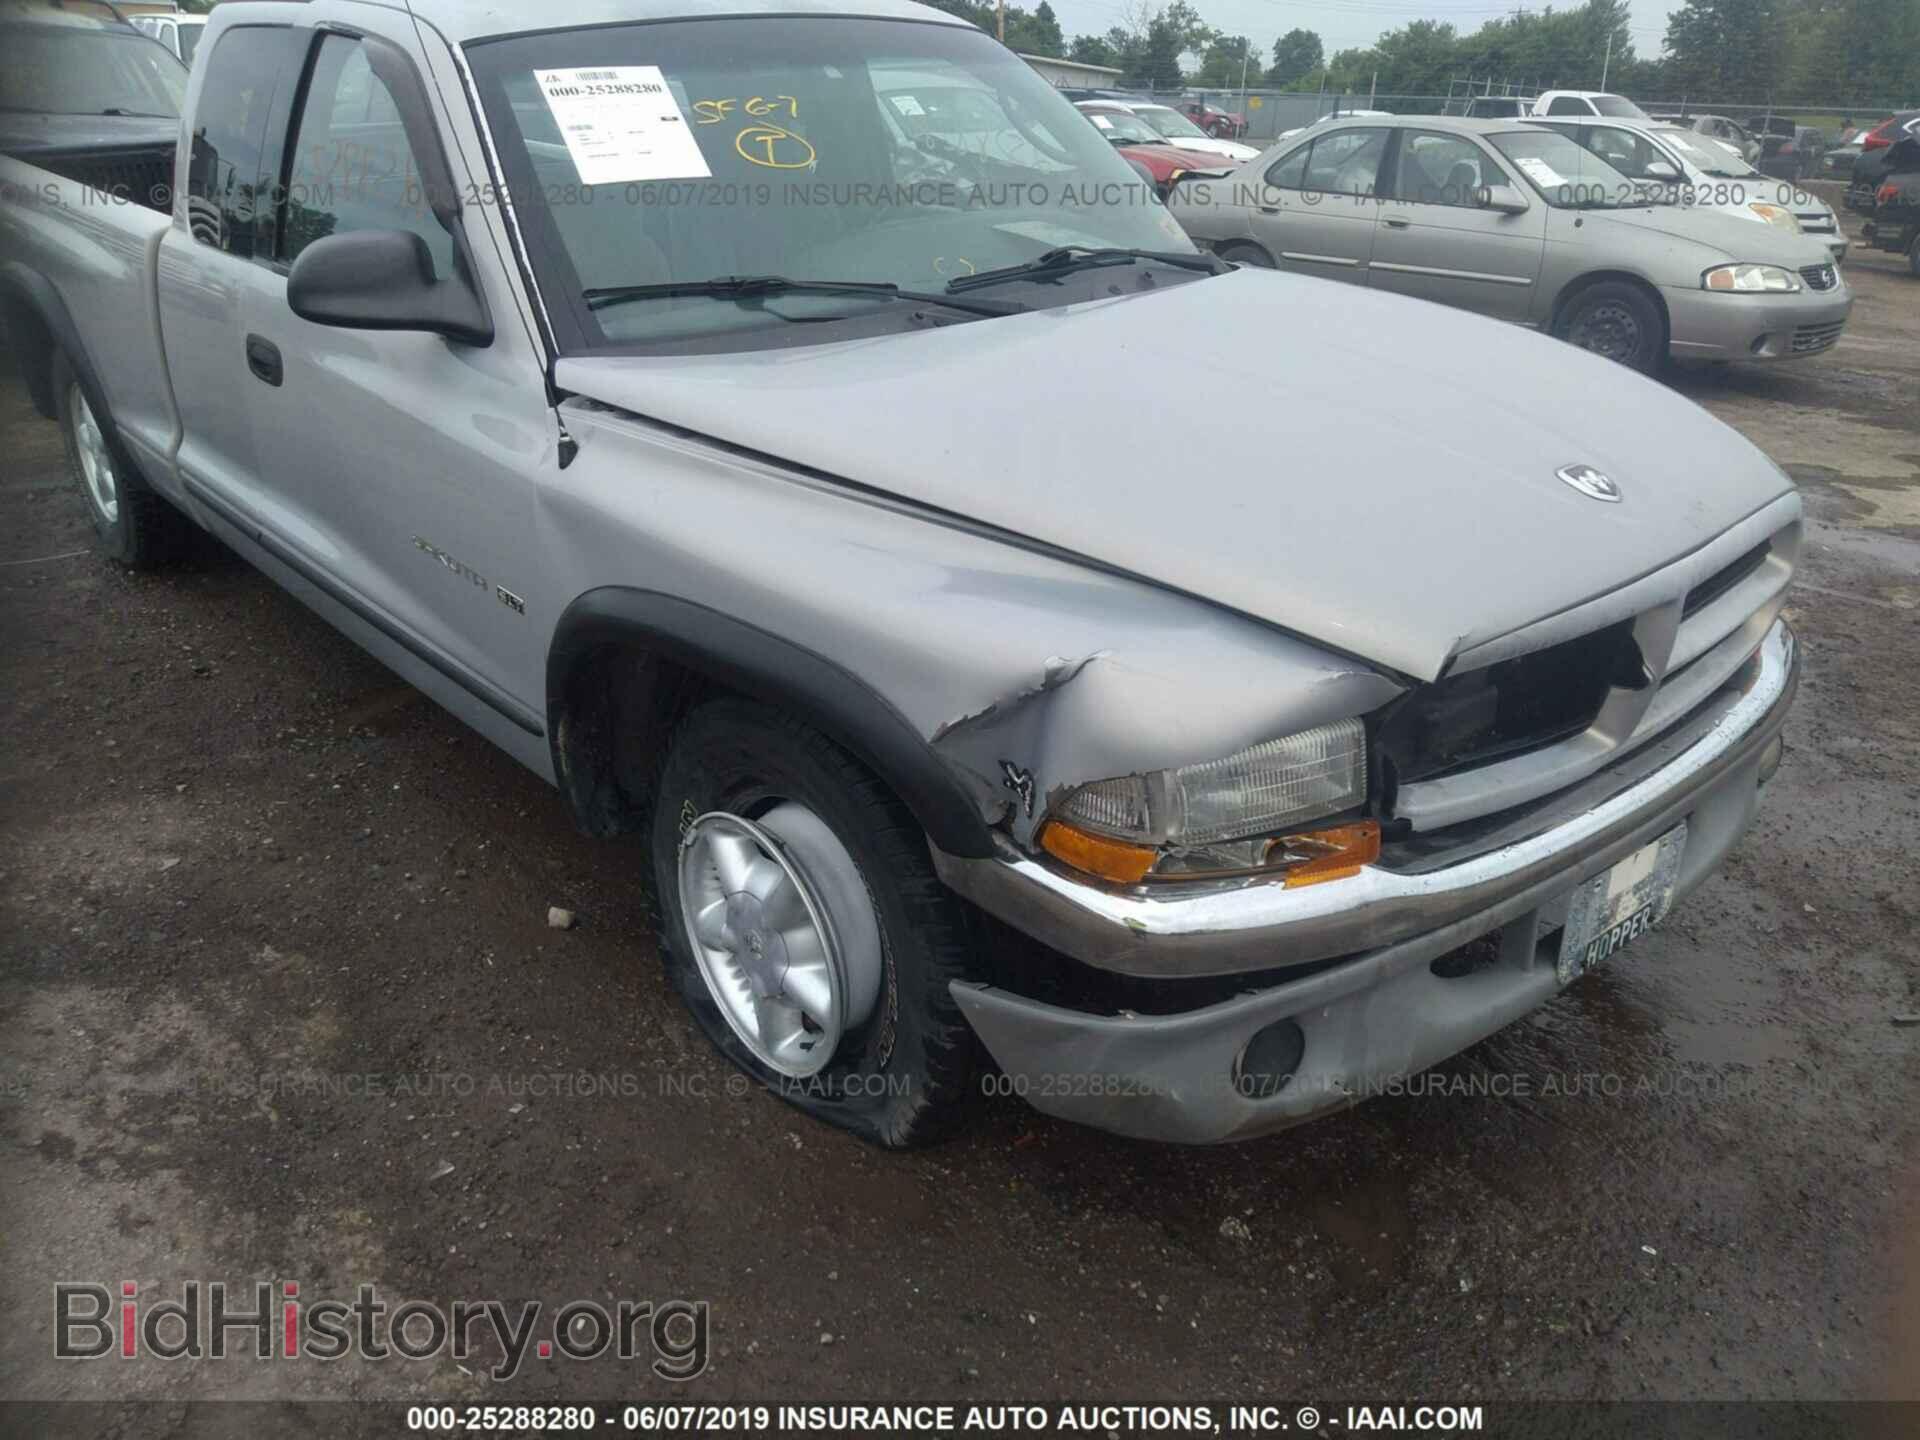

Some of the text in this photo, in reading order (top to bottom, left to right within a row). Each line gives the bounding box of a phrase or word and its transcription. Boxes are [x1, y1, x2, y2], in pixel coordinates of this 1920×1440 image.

[548, 82, 663, 98] 000-25288280
[692, 98, 737, 124] SF
[1586, 907, 1650, 968] HOPPER
